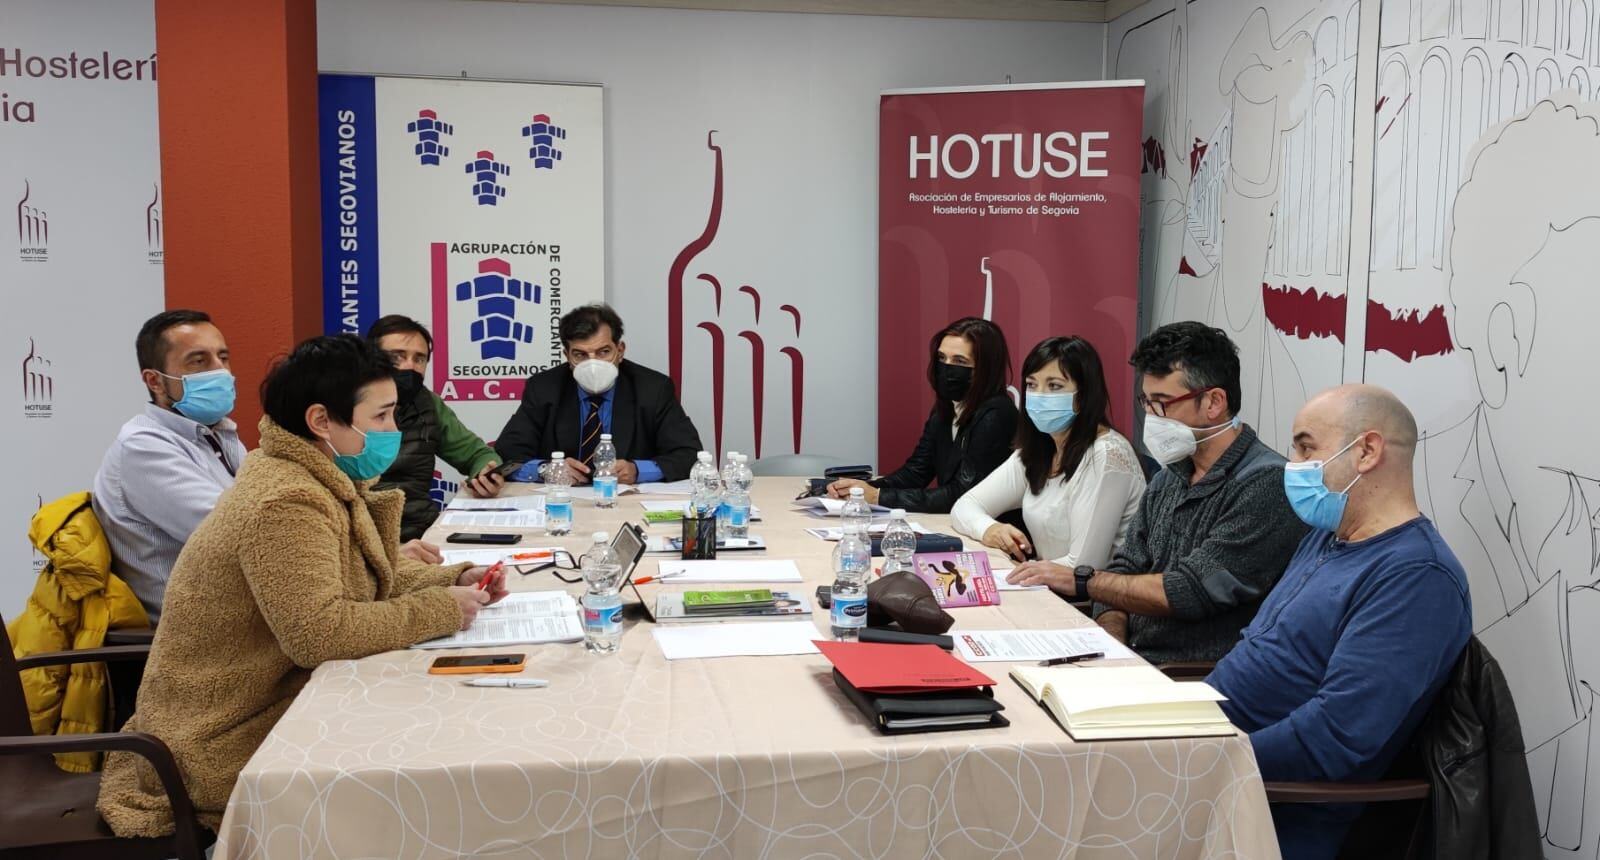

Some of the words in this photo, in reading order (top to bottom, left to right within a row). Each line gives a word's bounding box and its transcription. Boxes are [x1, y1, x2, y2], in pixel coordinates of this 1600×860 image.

[909, 131, 1109, 179] HOTUSE
[337, 109, 358, 252] SEGOVIANOS
[909, 192, 958, 202] Asociación
[960, 192, 972, 202] de
[974, 192, 1031, 205] Empresarios
[1034, 192, 1047, 202] de
[1049, 192, 1107, 204] Alojamiento,
[979, 208, 986, 217] y
[988, 205, 1023, 215] Turismo
[1026, 205, 1039, 215] de
[1041, 205, 1080, 216] Segovia
[450, 240, 547, 255] AGRUPACIÓN
[549, 244, 561, 263] DE
[452, 364, 549, 377] SEGOVIANOS
